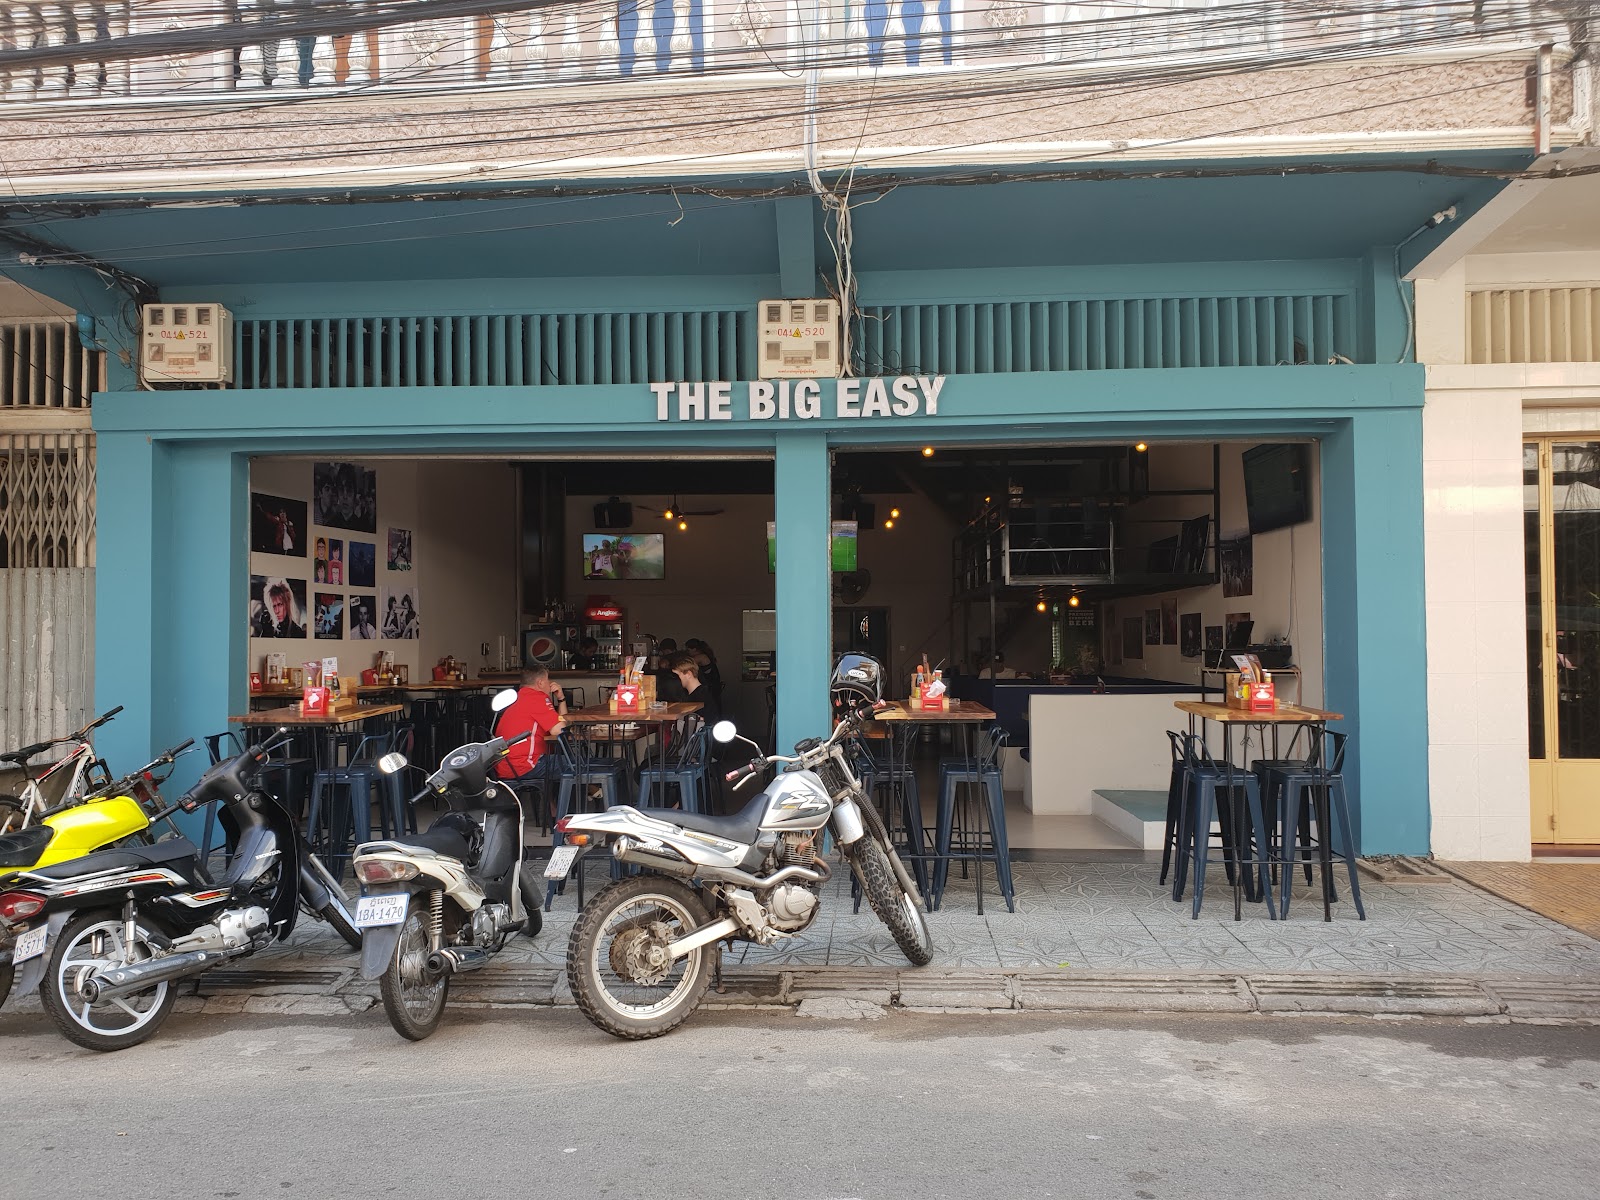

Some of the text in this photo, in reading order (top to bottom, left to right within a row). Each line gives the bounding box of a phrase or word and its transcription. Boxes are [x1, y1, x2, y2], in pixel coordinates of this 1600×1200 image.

[650, 376, 946, 421] THE BIG EASY
[635, 842, 665, 853] HONDA
[255, 849, 282, 860] HONDA
